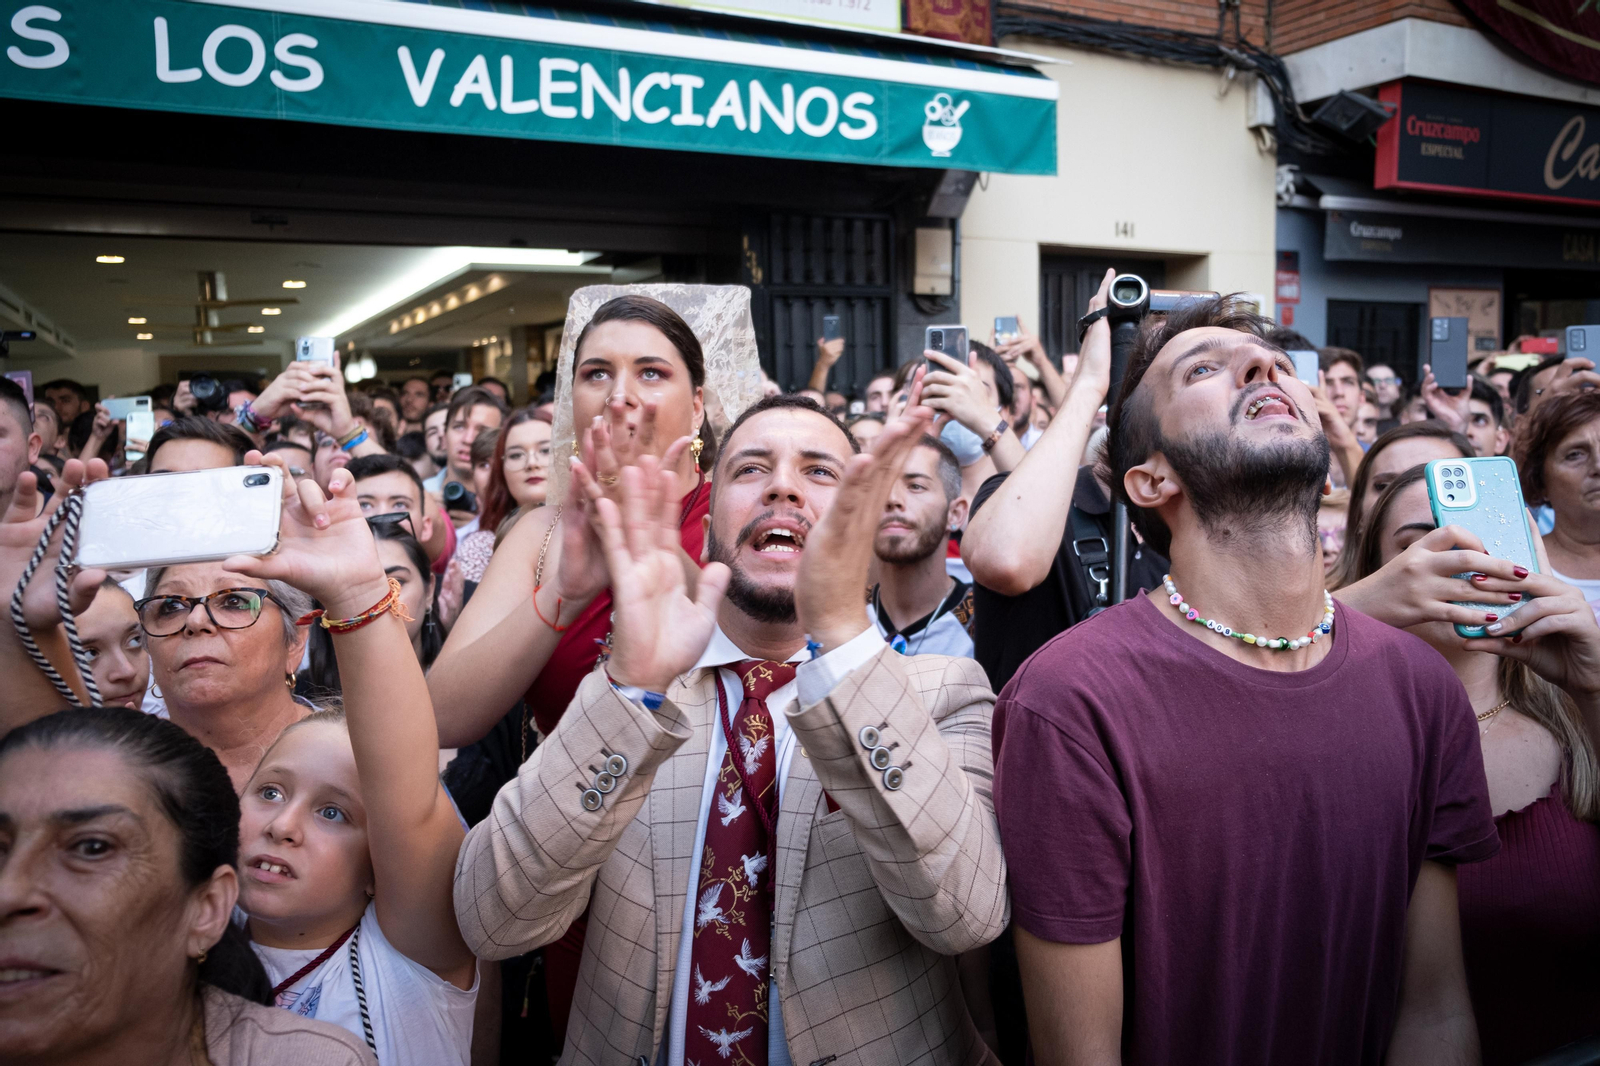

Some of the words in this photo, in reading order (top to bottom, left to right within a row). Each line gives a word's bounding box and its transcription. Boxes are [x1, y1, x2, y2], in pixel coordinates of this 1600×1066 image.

[6, 5, 70, 69] S
[154, 16, 324, 92] LOS
[397, 45, 878, 140] VALENCIANOS
[1406, 114, 1480, 145] Cruzcampo
[1115, 221, 1135, 238] 141
[1350, 221, 1403, 241] Cruzcampo
